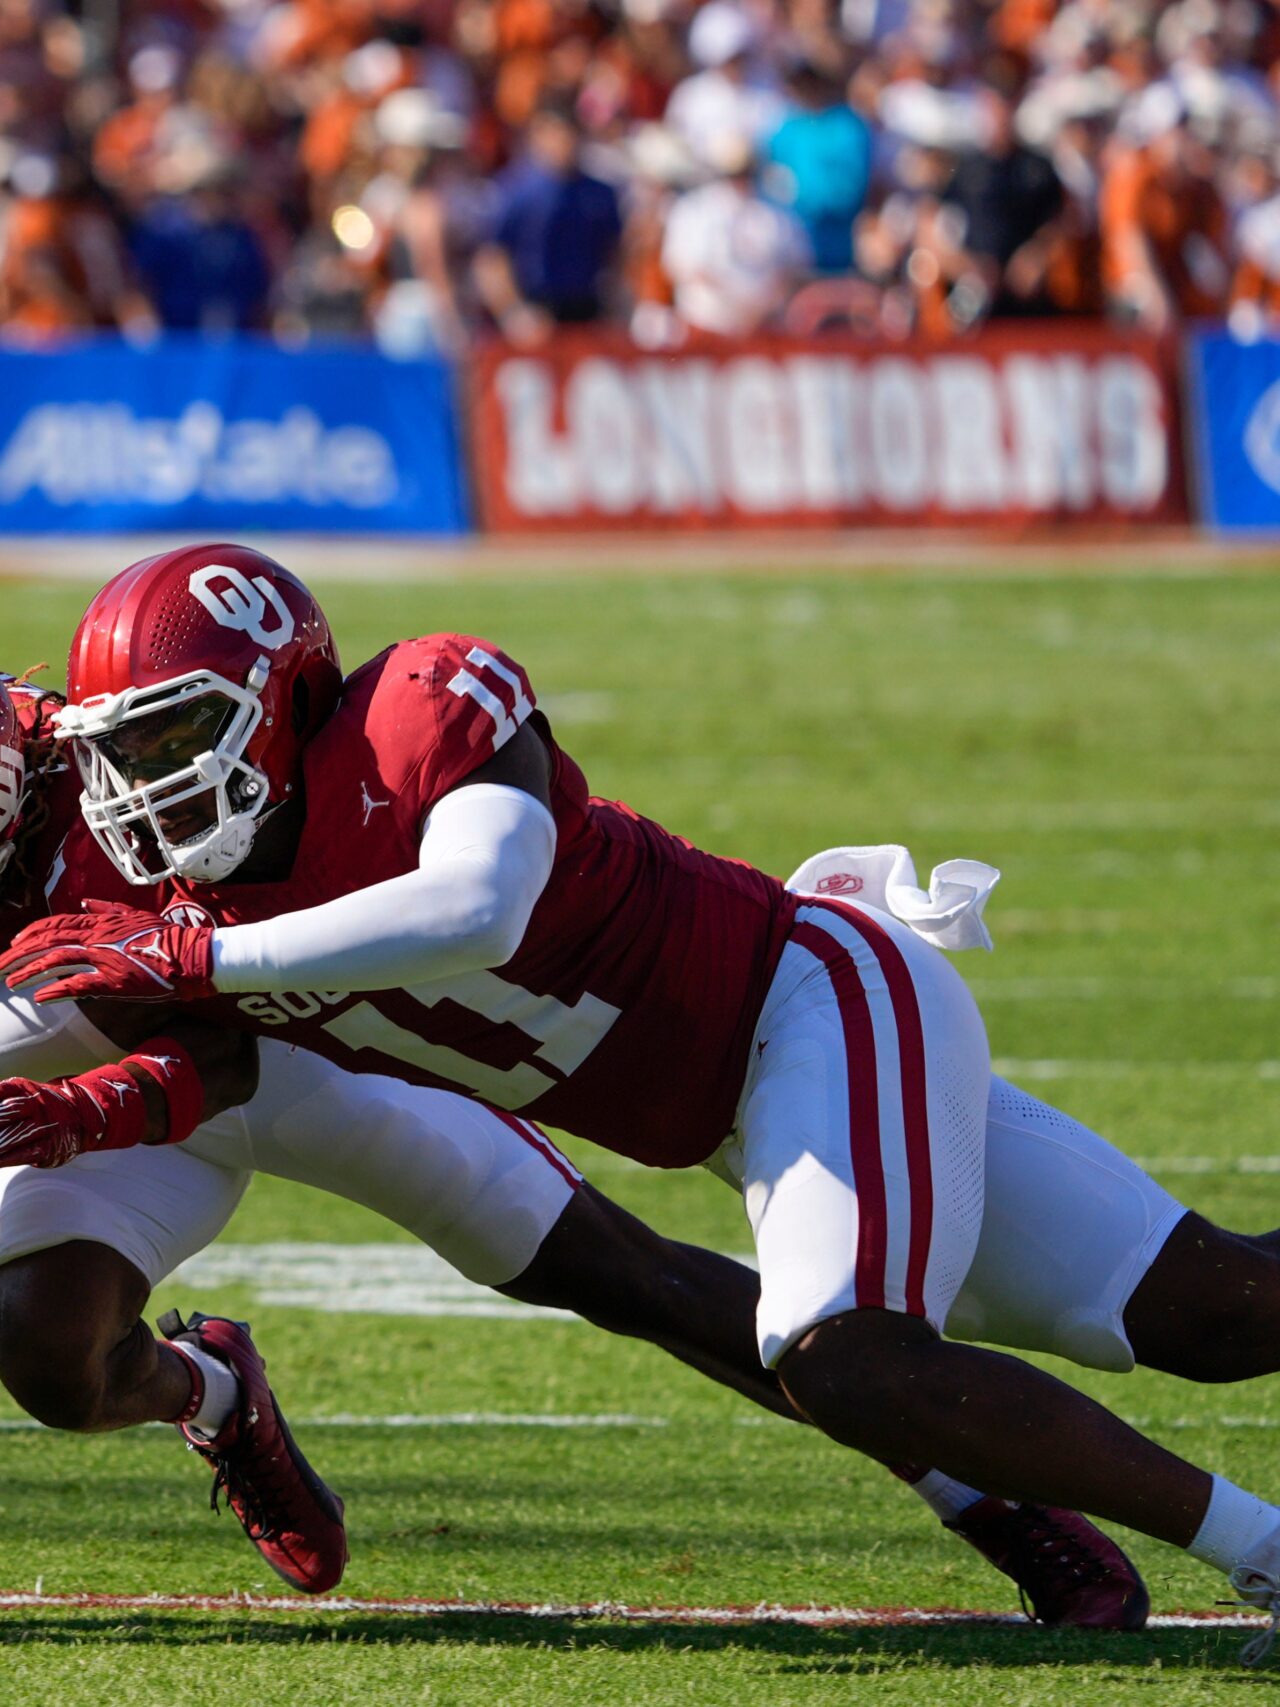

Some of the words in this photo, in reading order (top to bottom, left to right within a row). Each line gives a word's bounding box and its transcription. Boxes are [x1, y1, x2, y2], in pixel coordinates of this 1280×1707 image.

[495, 352, 1168, 516] LONGHORNS
[188, 564, 296, 651] OU
[446, 646, 535, 753] 11
[320, 968, 622, 1111] 11
